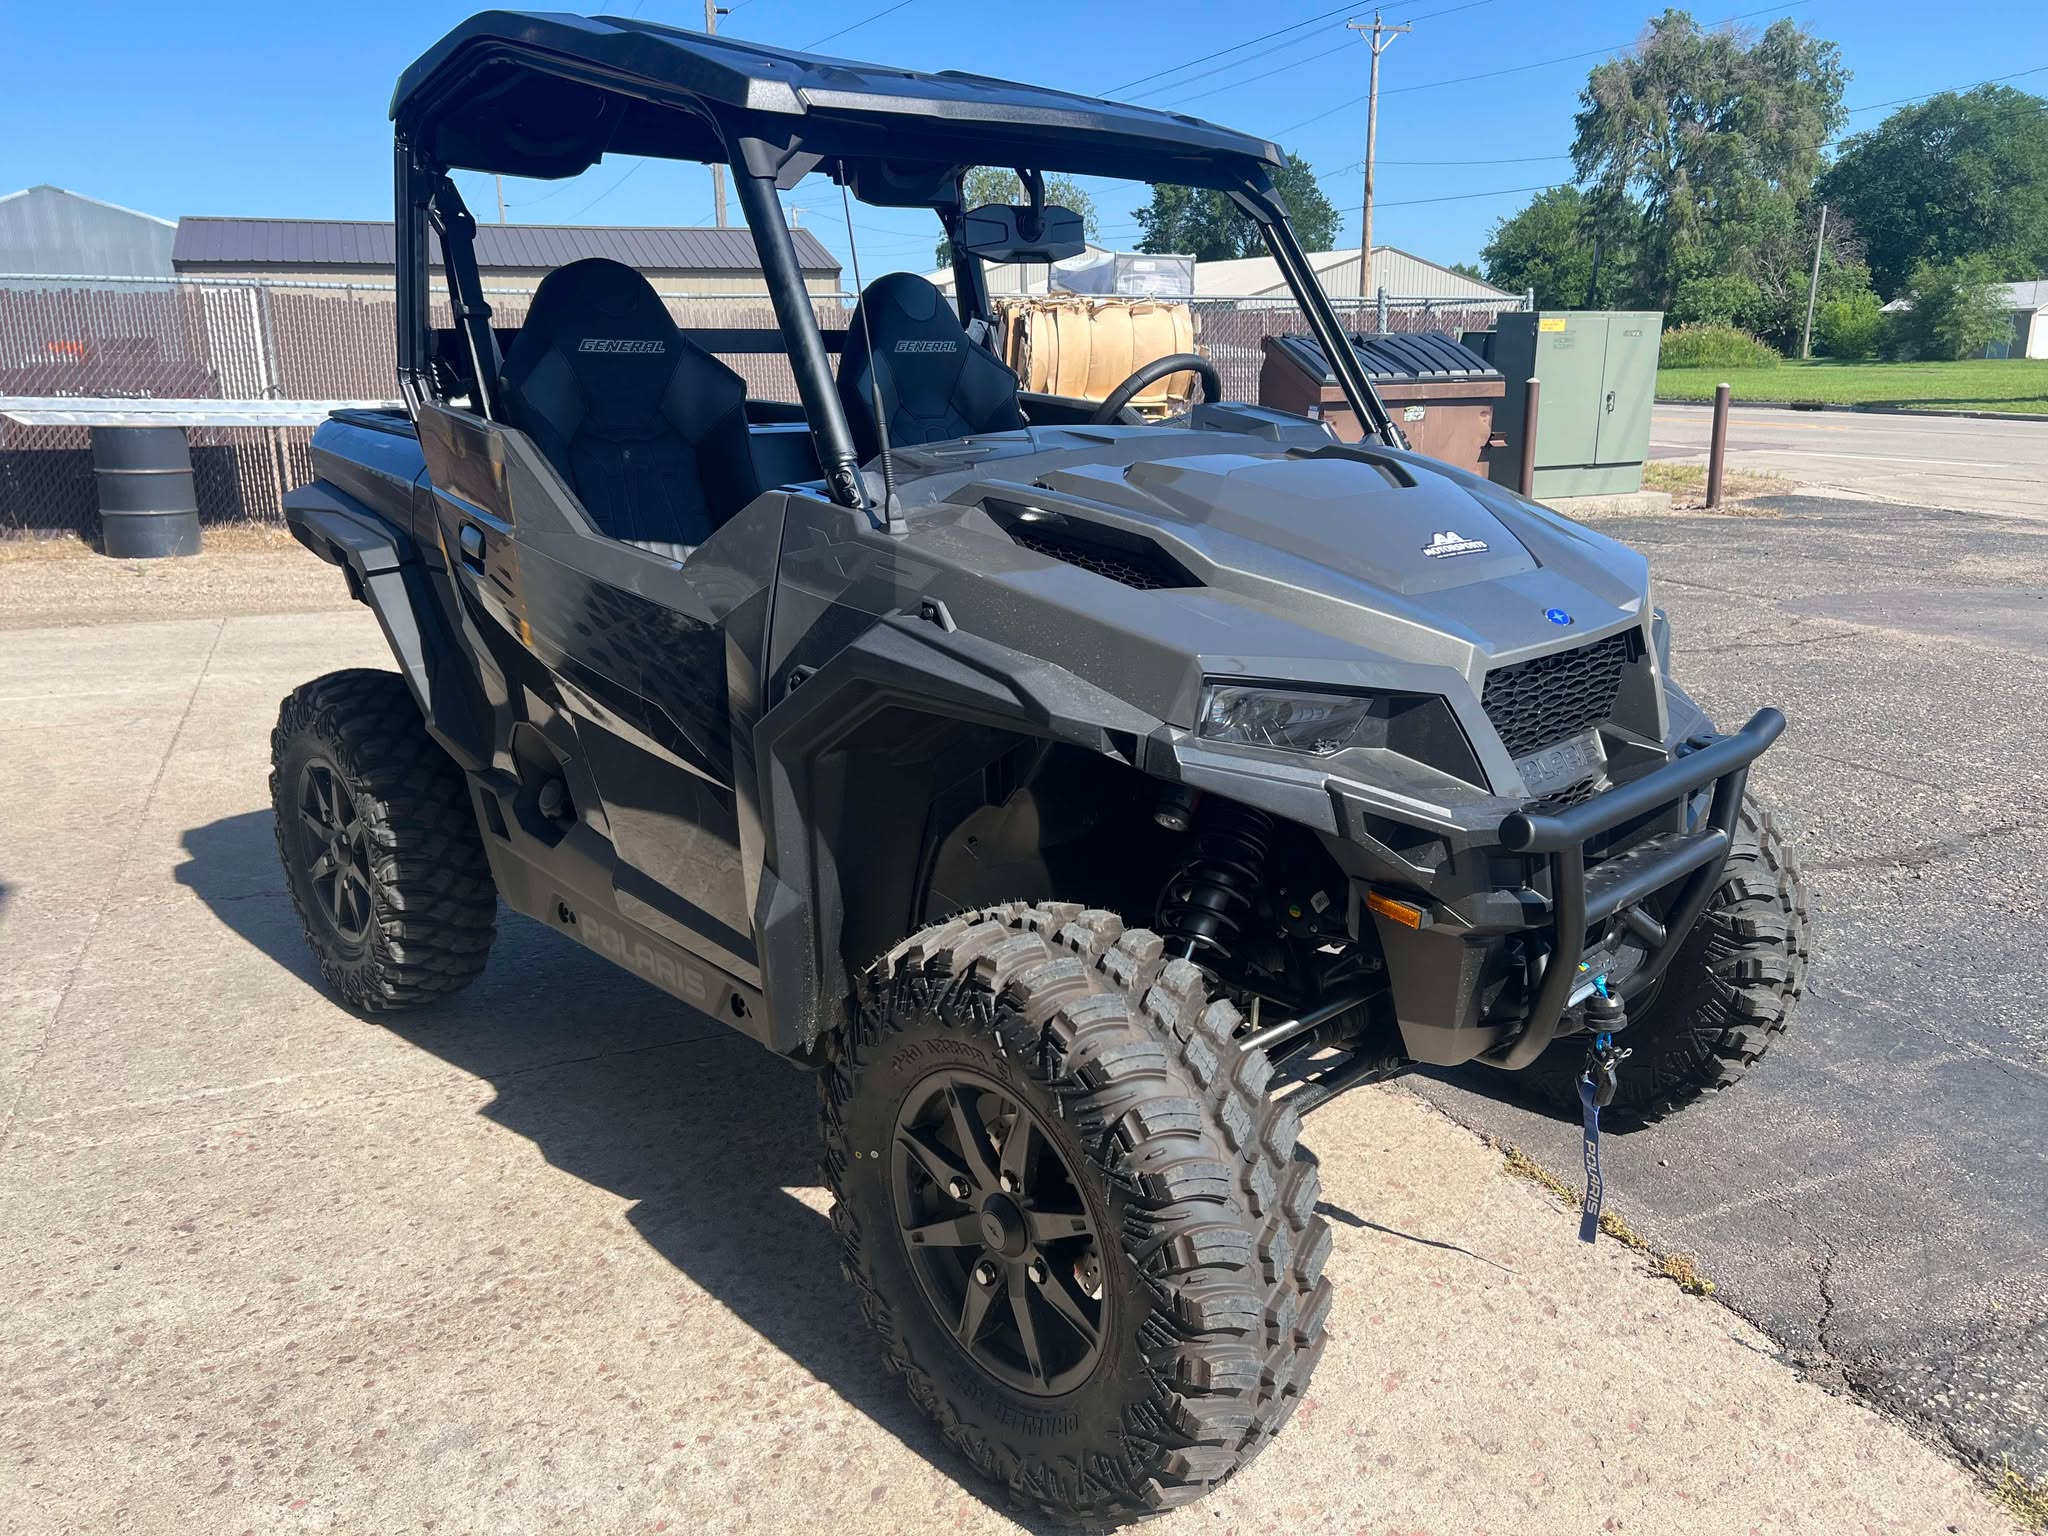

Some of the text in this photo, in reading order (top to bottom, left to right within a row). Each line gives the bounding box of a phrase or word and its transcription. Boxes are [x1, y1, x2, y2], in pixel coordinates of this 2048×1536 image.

[578, 339, 665, 353] GENERAL
[894, 340, 957, 352] GENERAL
[1423, 540, 1488, 556] MOTORSPORTS
[1516, 740, 1601, 786] OLARIS
[580, 913, 706, 1000] POLARIS
[1585, 1139, 1602, 1216] POLARIS
